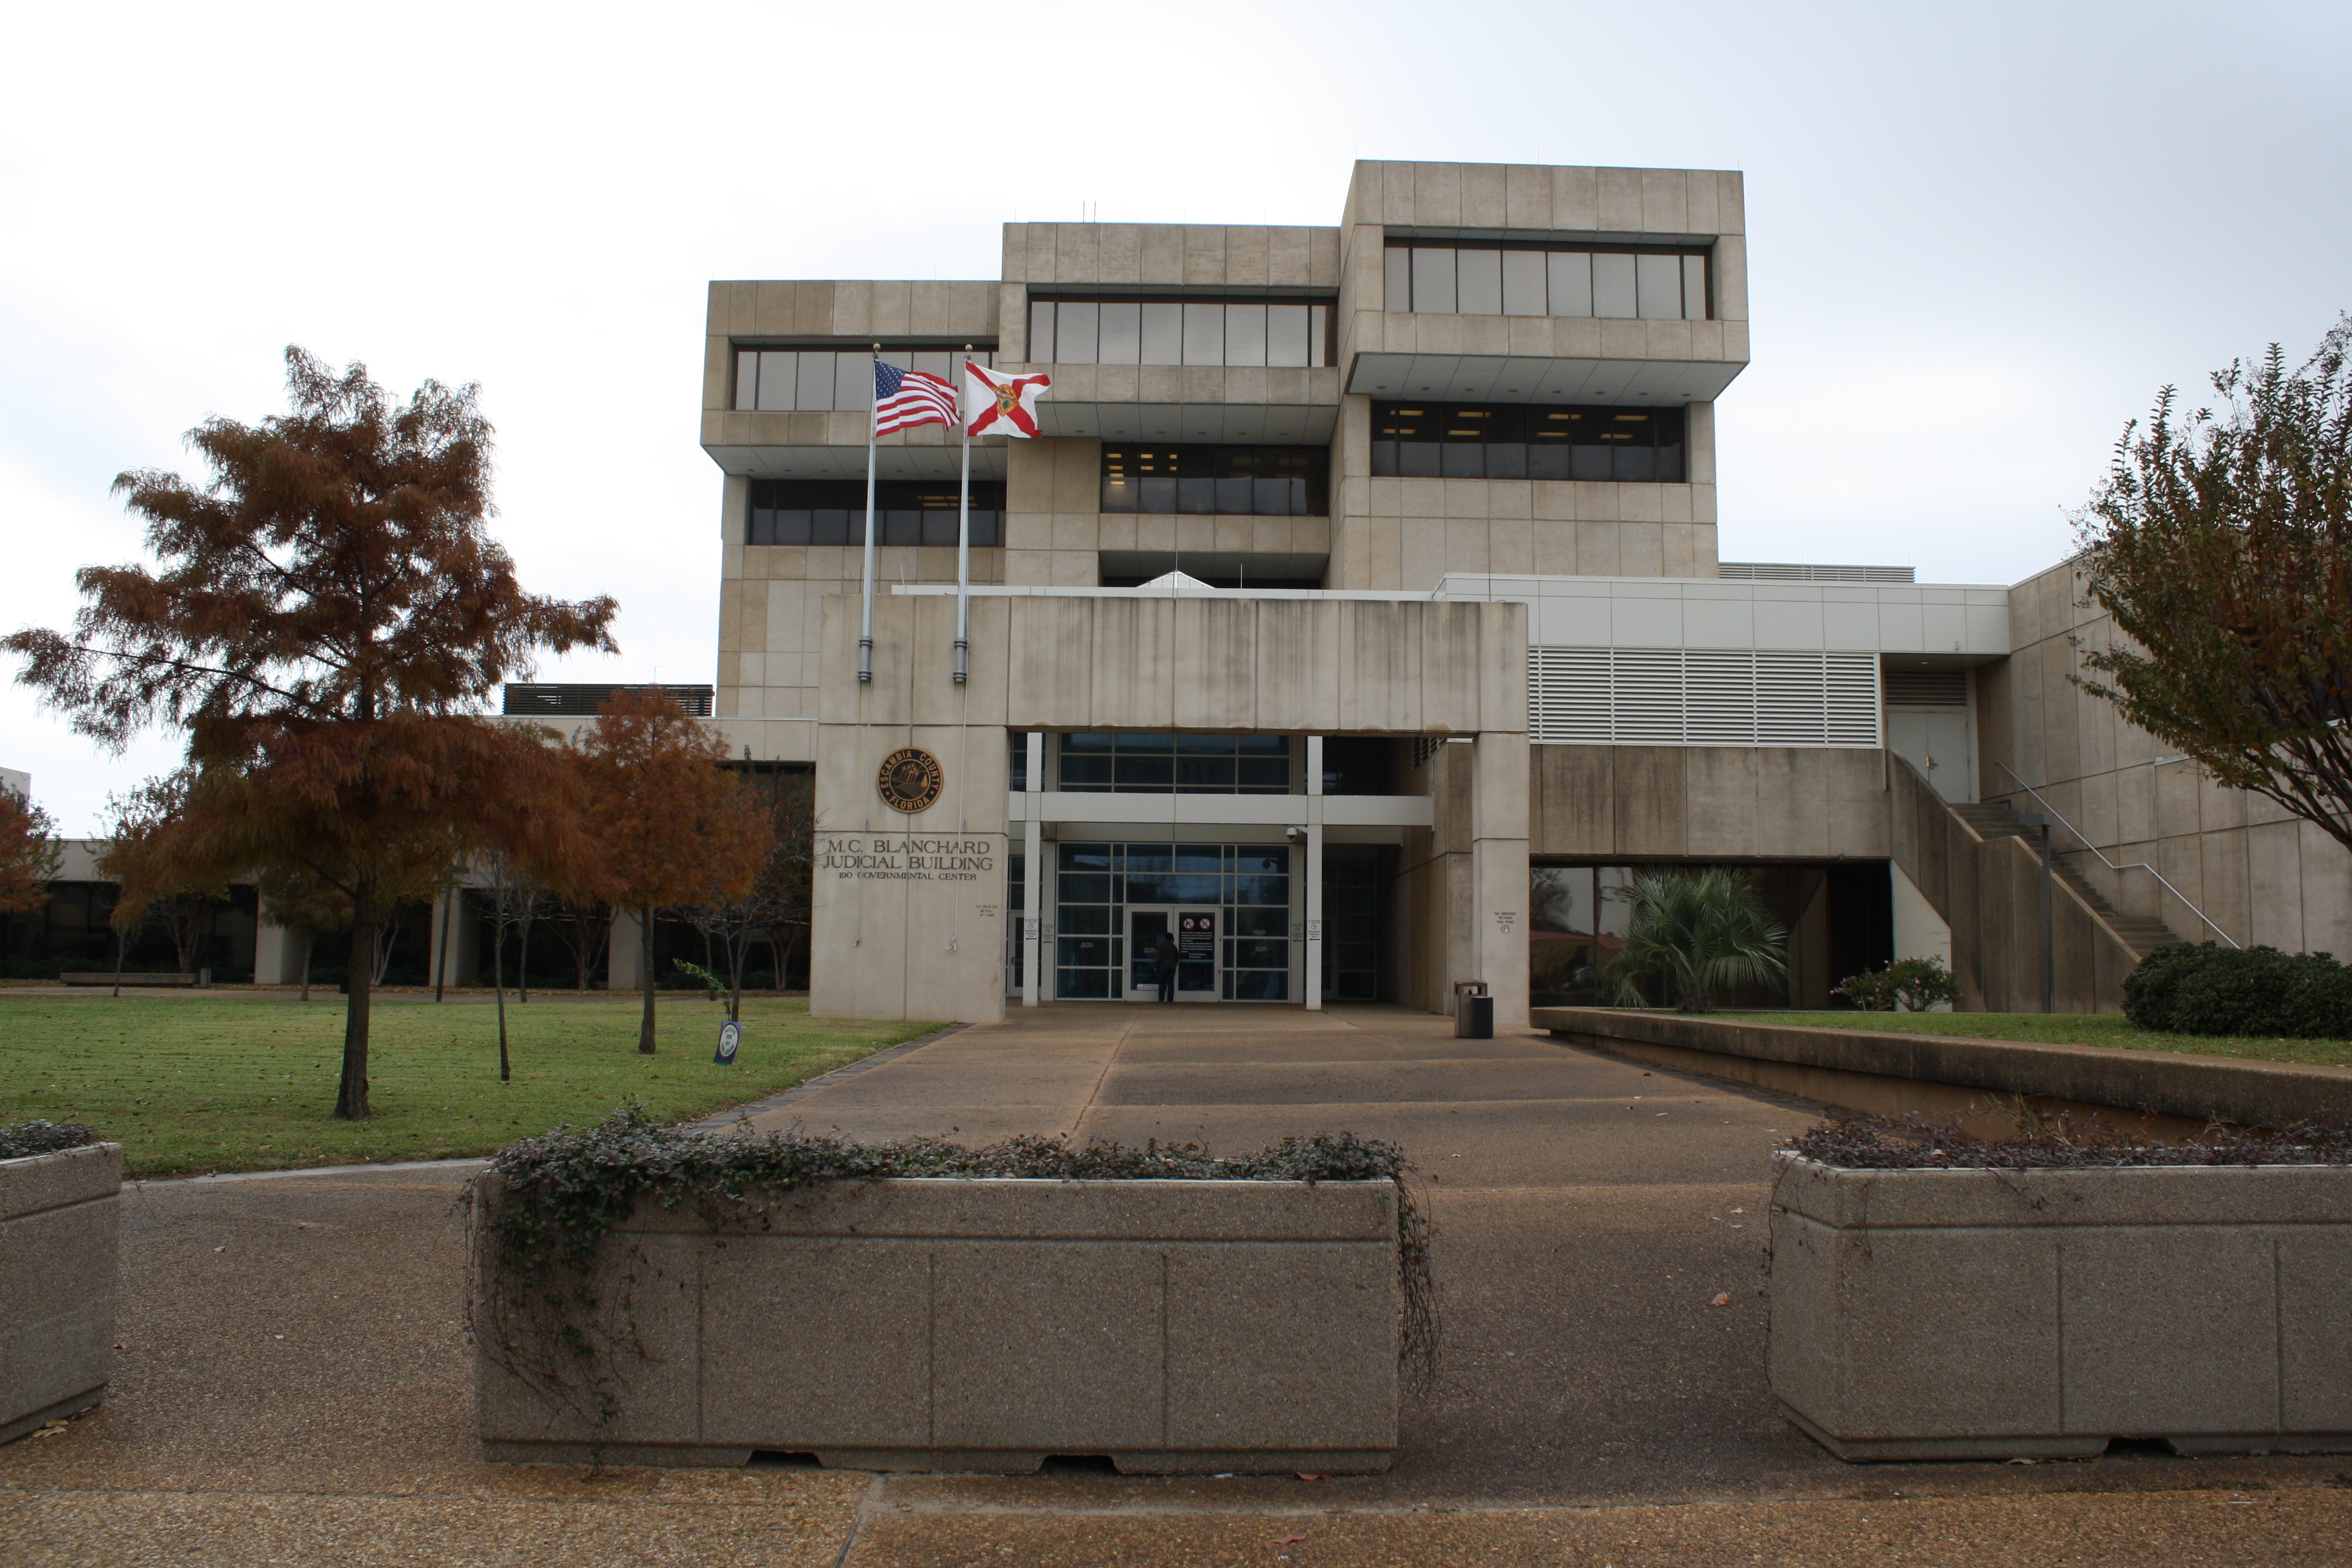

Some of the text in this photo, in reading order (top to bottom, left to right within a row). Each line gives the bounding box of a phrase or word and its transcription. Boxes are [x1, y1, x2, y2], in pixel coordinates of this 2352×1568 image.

[880, 750, 939, 789] ESCAMBIA COUNTY
[889, 796, 930, 809] FLORIDA
[874, 840, 990, 854] BLANCHARD
[823, 855, 993, 871] JUDICIAL BUILDING
[857, 872, 934, 880] GOVERNMENTAL
